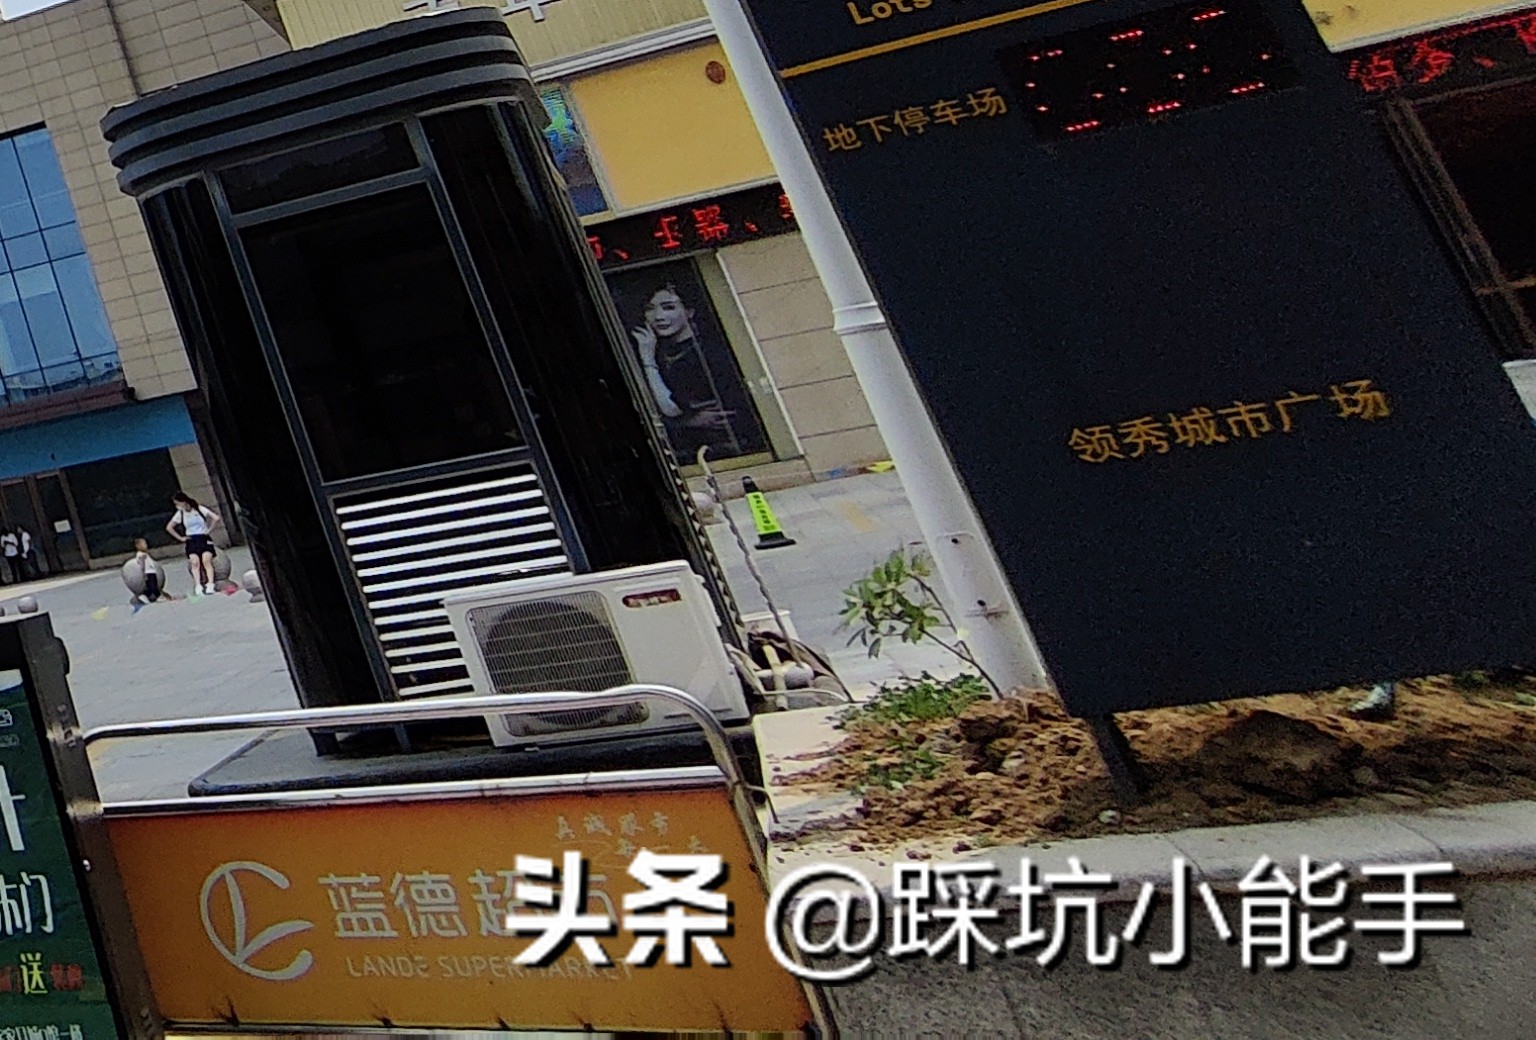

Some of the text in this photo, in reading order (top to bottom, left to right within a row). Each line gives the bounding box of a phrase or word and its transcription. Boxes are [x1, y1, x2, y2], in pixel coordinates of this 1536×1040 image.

[821, 89, 1008, 154] 地下停车场
[1068, 379, 1392, 463] 领秀城市广场
[441, 954, 635, 980] SUPERARKET
